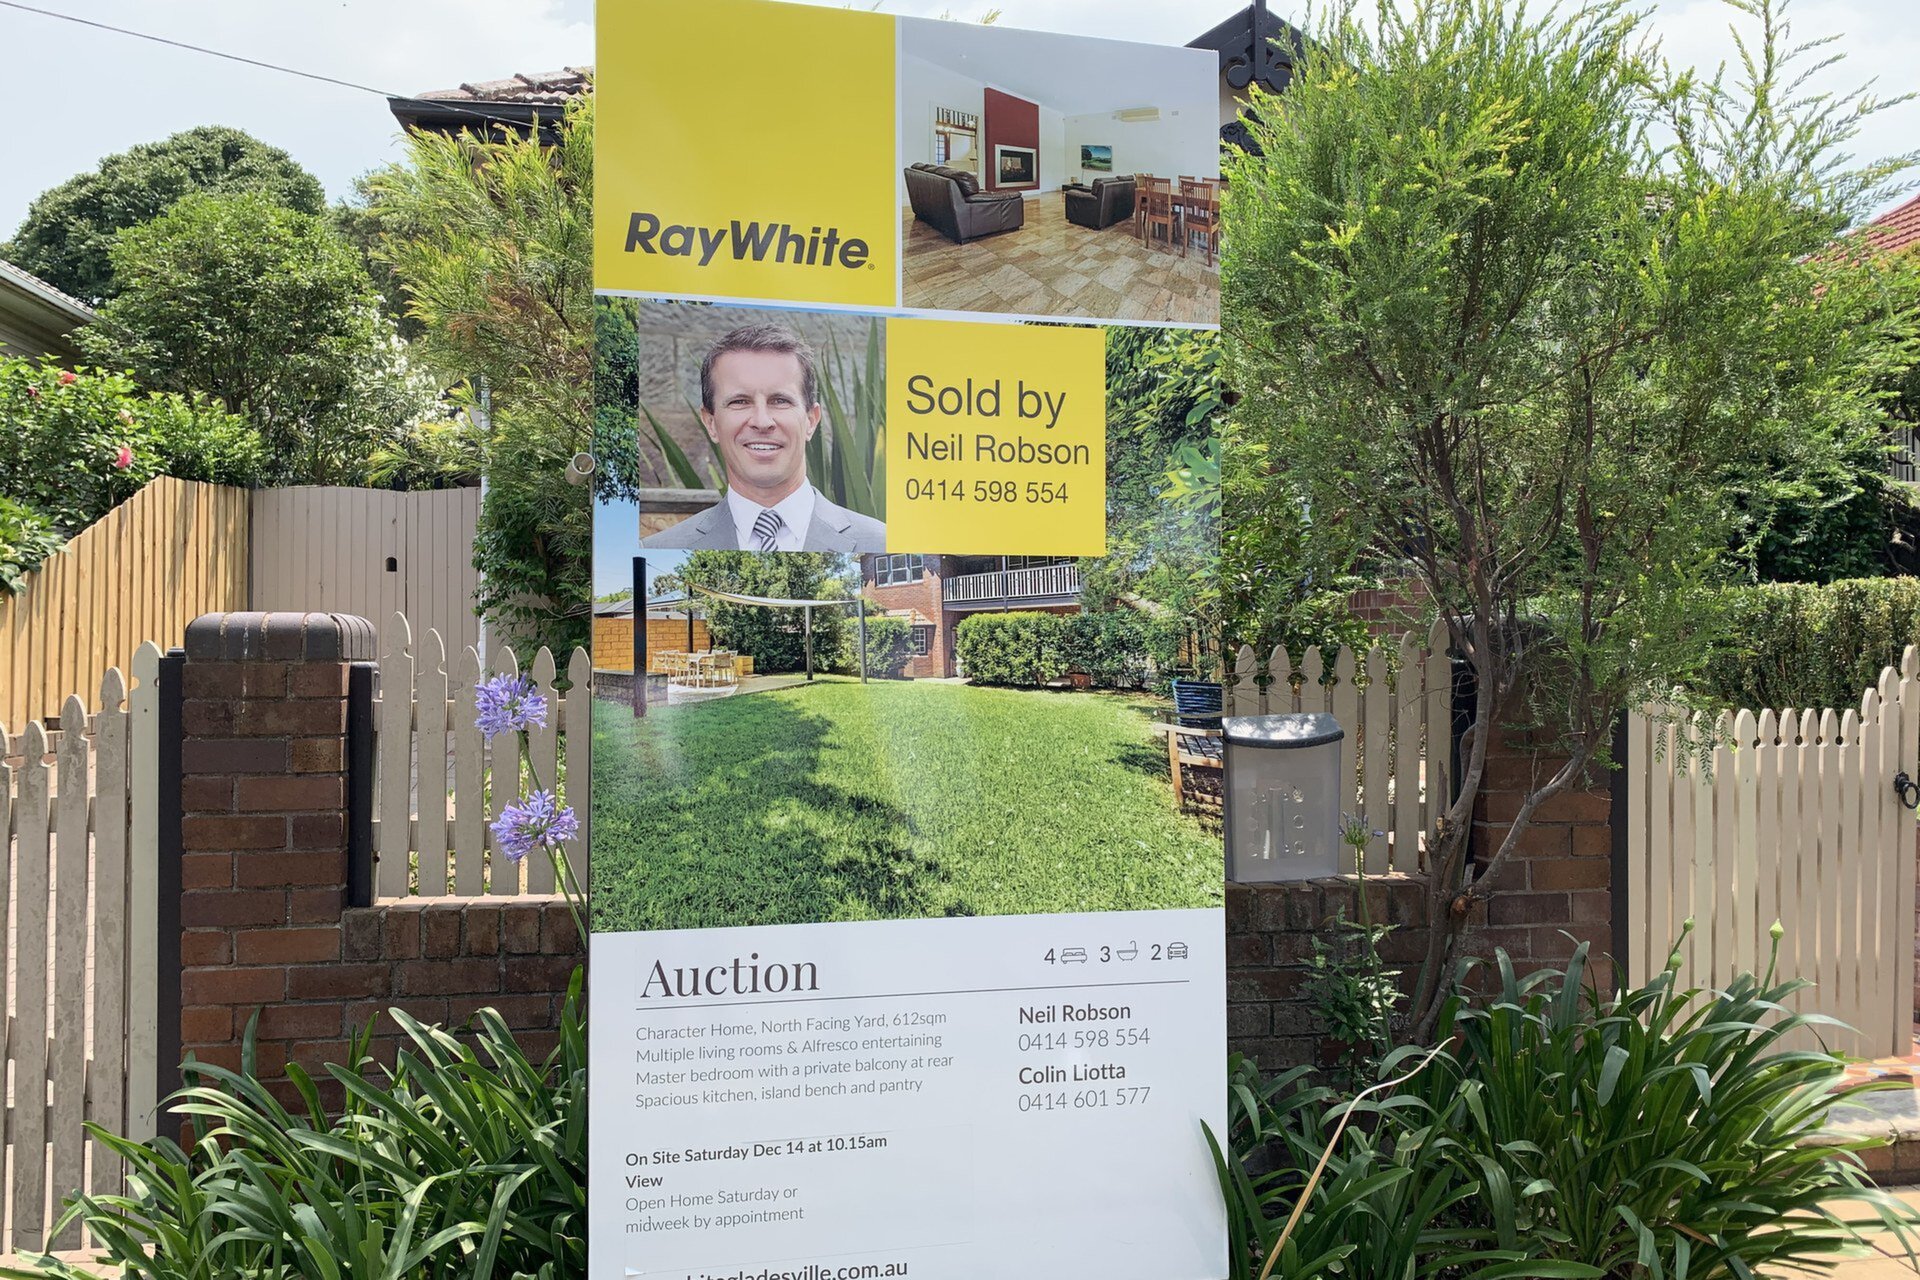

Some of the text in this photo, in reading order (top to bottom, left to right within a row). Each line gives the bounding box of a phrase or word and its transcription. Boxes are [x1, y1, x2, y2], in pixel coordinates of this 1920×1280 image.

[906, 374, 1067, 429] Sold by
[907, 431, 1089, 465] Neil Robson
[905, 478, 1069, 504] 0414 598 554
[1043, 943, 1162, 965] 4 3 2
[639, 952, 820, 999] Auction
[635, 1011, 947, 1041] Character Home, North Facing Yard, 612sqm
[1019, 1003, 1131, 1025] Neil Robson
[636, 1033, 943, 1064] Multiple living rooms & Alfresco entertaining
[1018, 1027, 1151, 1052] 0414 598 554
[636, 1055, 954, 1086] Master bedroom with a private balcony at rear
[1018, 1063, 1126, 1085] Colin Liotta
[635, 1078, 923, 1110] Spacious kitchen, island bench and pantry
[1018, 1086, 1151, 1112] 0414 601 577
[625, 1135, 888, 1167] On Site Saturday Dec 14 at 10.15am
[625, 1174, 664, 1189] View
[625, 1187, 798, 1213] Open Home Saturday or
[625, 1206, 804, 1234] midweek by appointment
[686, 1262, 908, 1280] ldesville.com.au
